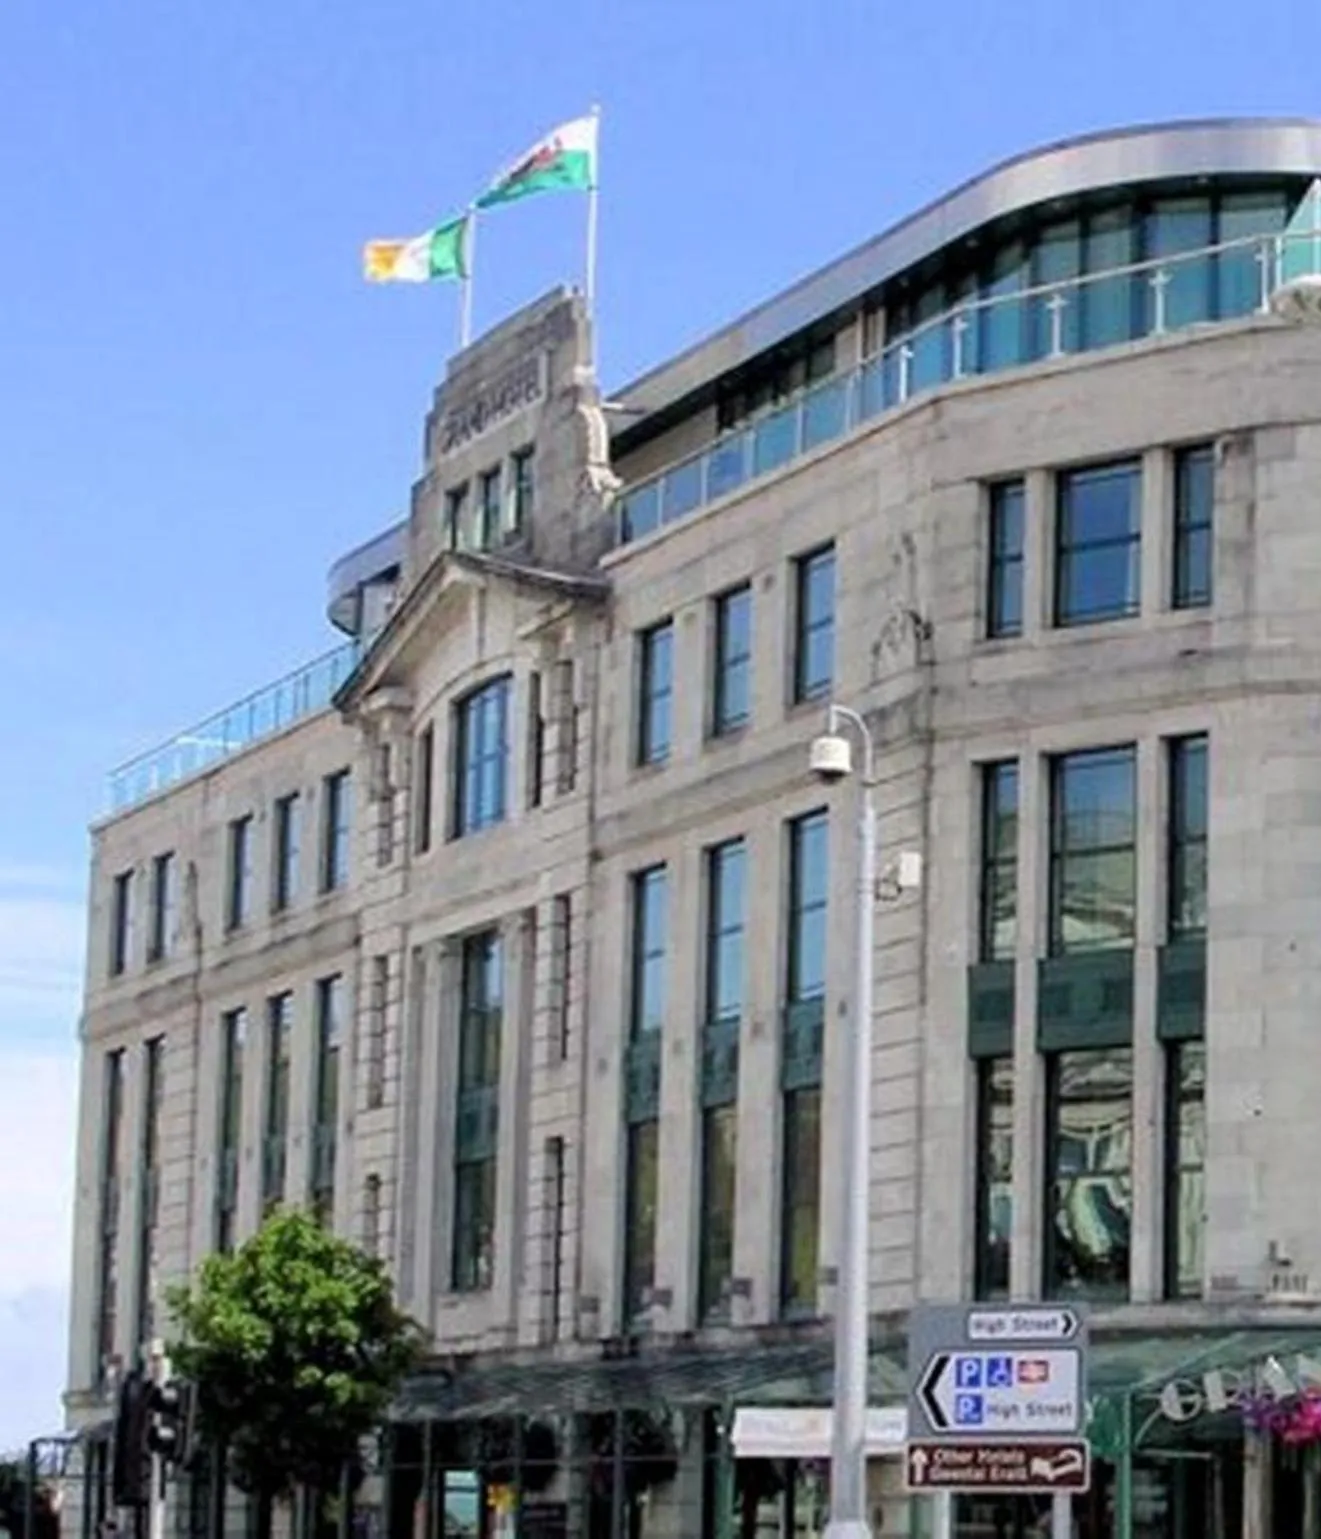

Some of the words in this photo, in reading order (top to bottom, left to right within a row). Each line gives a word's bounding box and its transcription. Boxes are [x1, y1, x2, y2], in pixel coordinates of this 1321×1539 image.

[974, 1317, 1005, 1333] High
[1013, 1315, 1057, 1331] Street
[988, 1404, 1019, 1420] High
[1026, 1402, 1072, 1417] Street
